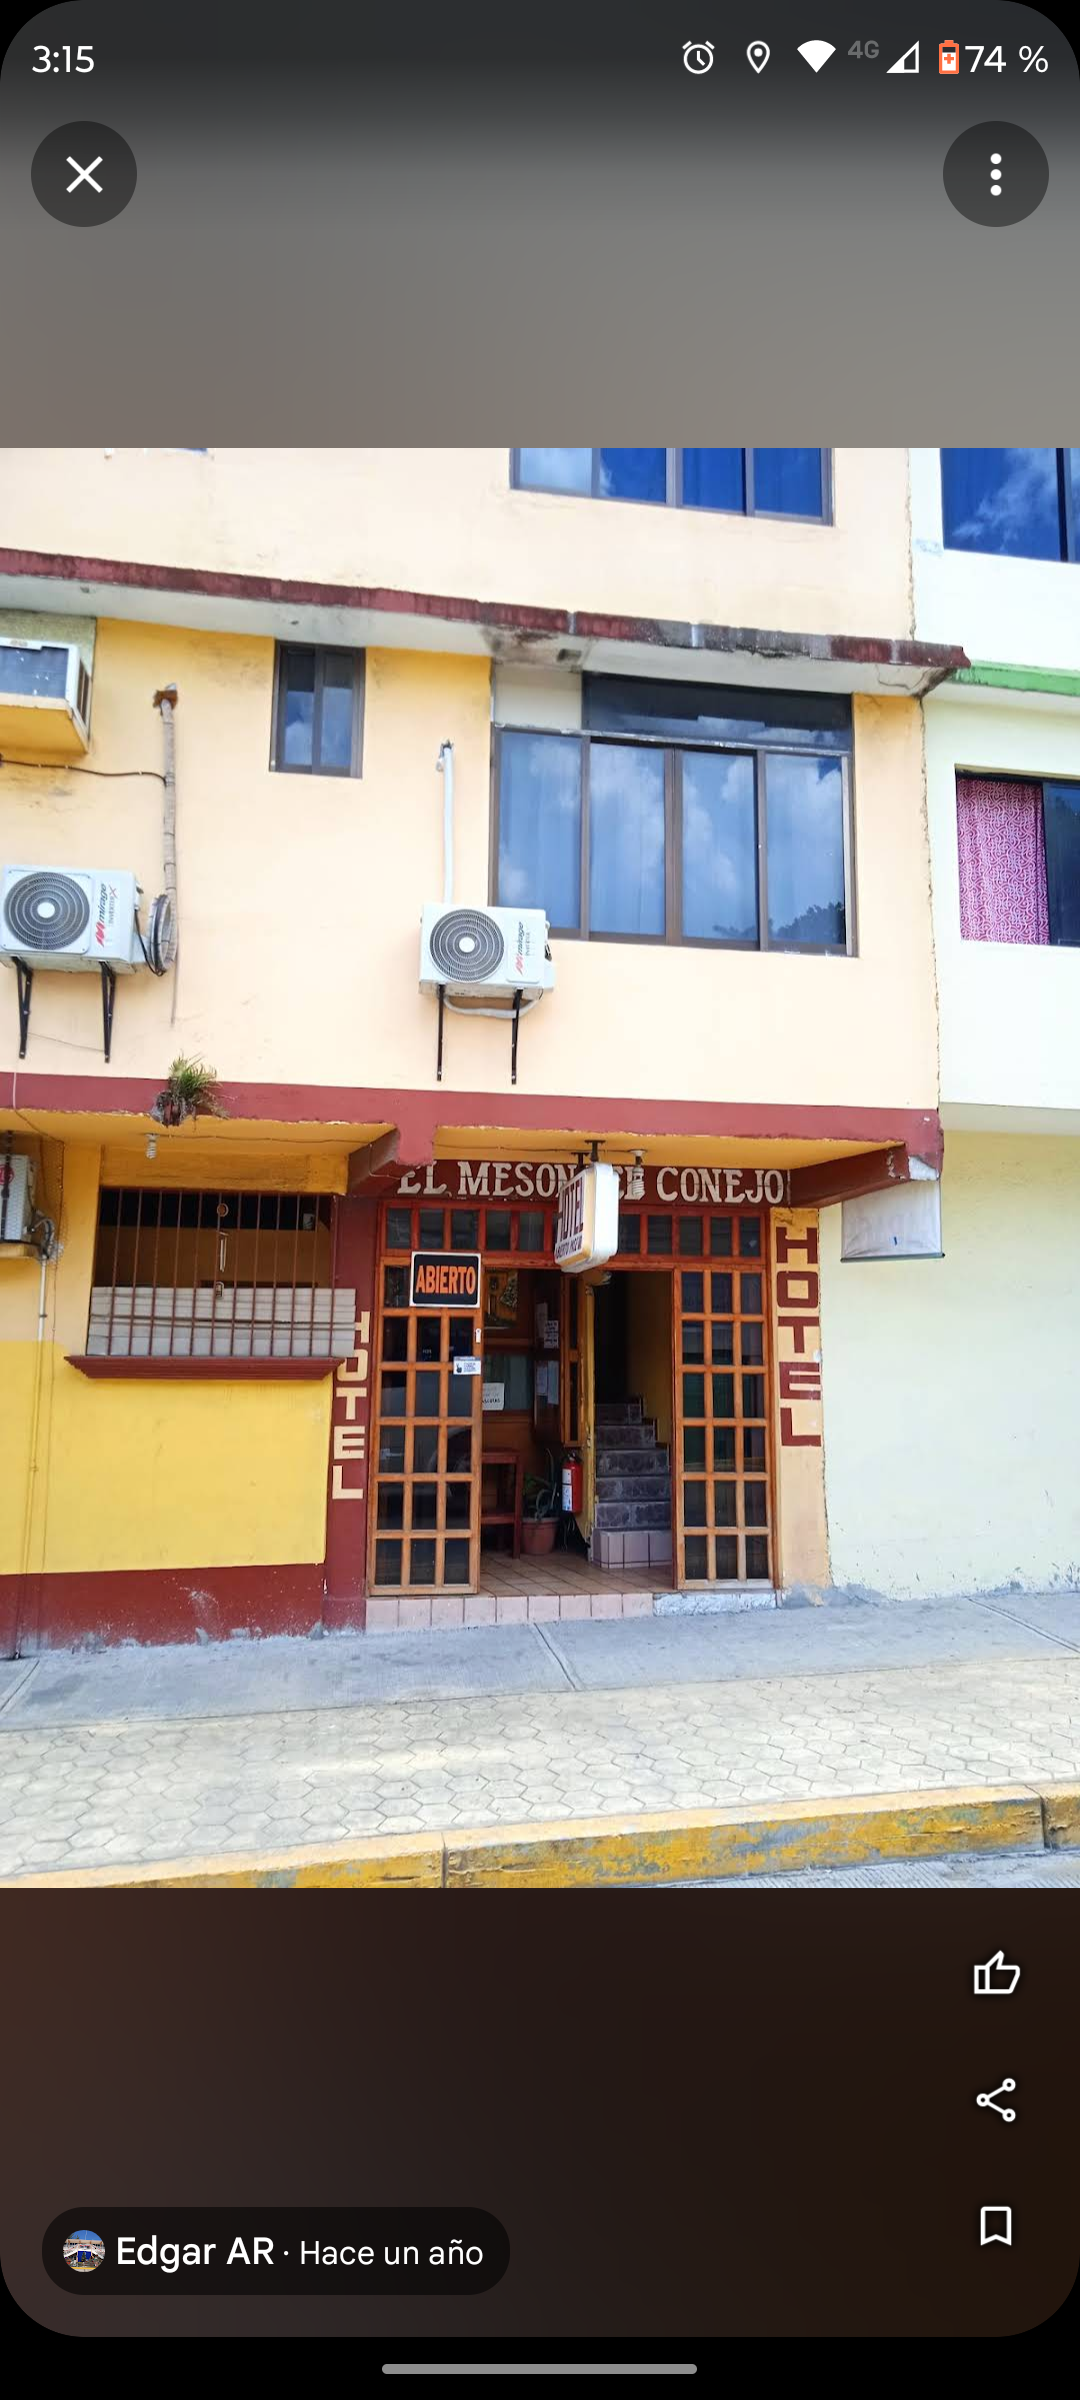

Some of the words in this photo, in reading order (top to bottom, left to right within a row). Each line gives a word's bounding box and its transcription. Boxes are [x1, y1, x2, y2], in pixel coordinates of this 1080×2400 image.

[656, 1166, 785, 1204] CONEJO
[415, 1264, 476, 1296] ABIERTO
[775, 1226, 822, 1447] HOTEL
